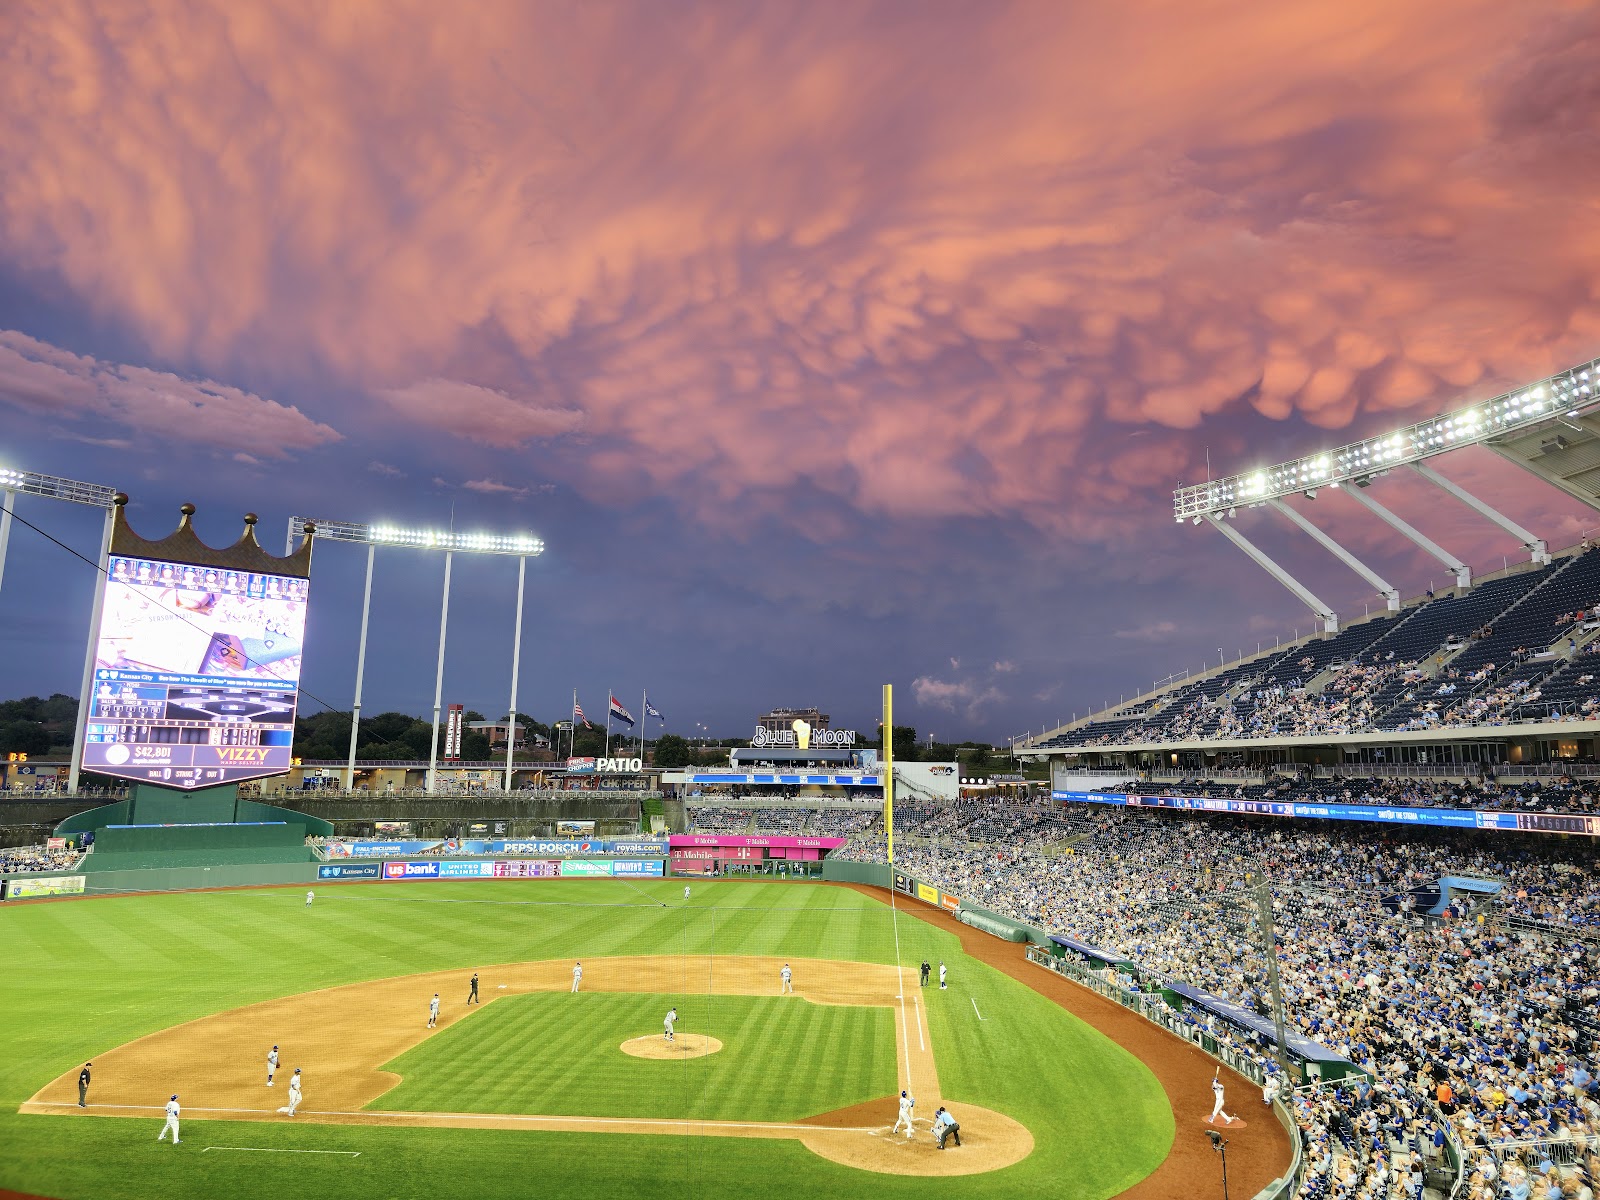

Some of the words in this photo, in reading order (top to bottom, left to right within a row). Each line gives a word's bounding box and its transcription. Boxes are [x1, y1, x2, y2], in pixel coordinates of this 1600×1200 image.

[250, 583, 264, 592] BAT
[446, 714, 454, 754] BOULEVARD
[753, 726, 794, 747] BLUE
[813, 728, 856, 744] MOON
[9, 752, 28, 762] 0:15
[135, 746, 171, 758] $42,801
[216, 748, 272, 760] VIZZY
[568, 762, 594, 772] CHOPPER
[596, 758, 642, 772] PATIO
[164, 768, 171, 779] 0
[195, 768, 202, 780] 2
[220, 769, 225, 780] 1
[568, 778, 595, 788] PRICE
[601, 778, 646, 789] CHOPPER
[504, 843, 536, 852] PEPSI
[538, 844, 578, 852] PORCH
[389, 866, 404, 874] us
[406, 863, 437, 874] bank
